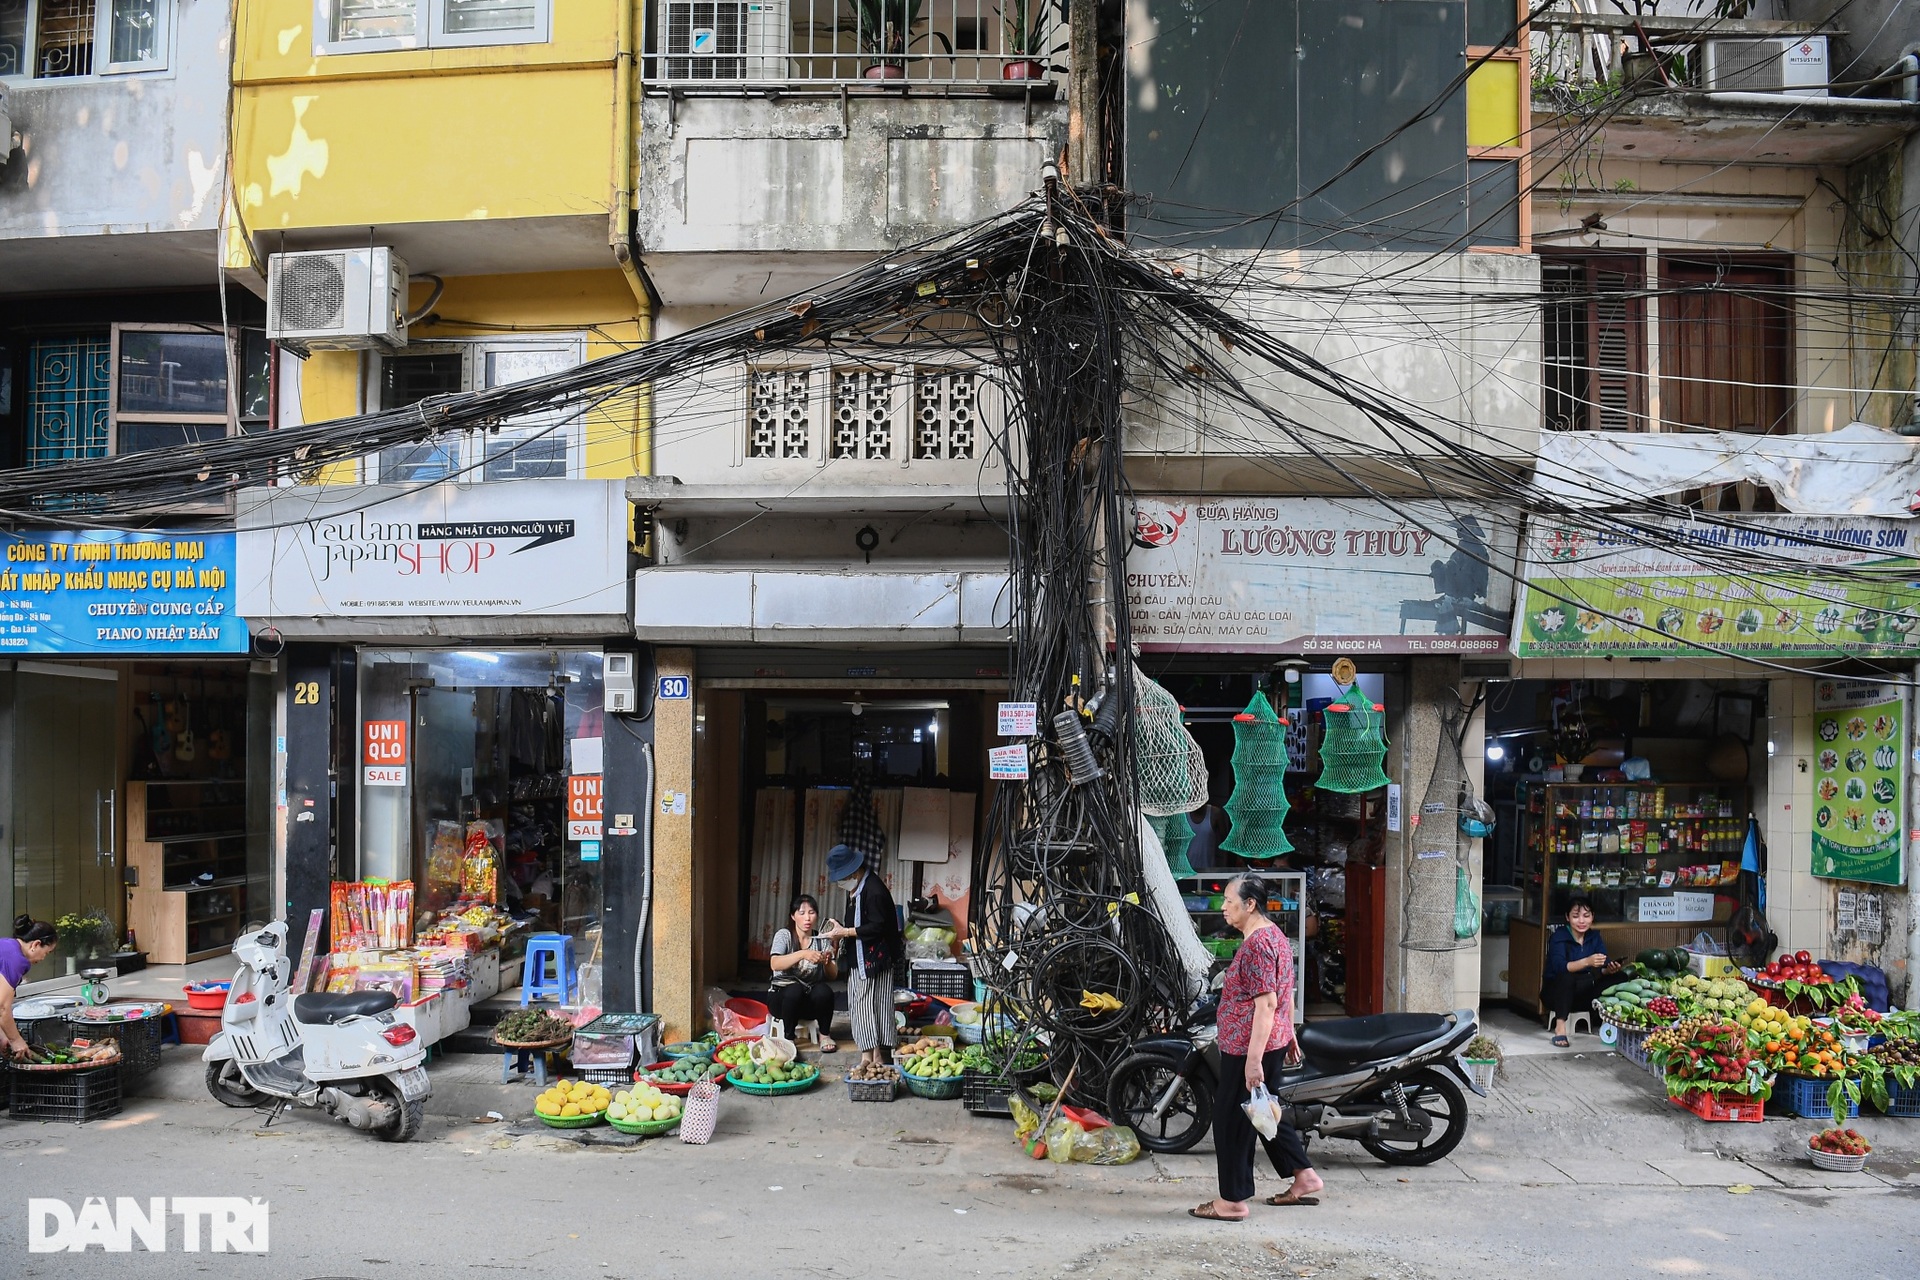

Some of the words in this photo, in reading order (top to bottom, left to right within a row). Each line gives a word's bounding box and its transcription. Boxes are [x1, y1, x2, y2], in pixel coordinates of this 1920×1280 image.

[1196, 502, 1228, 520] CỬA
[1232, 502, 1278, 521] HÀNG
[421, 525, 452, 537] HÀNG
[455, 524, 484, 538] NHẬT
[486, 525, 508, 536] CHO
[511, 520, 545, 535] NGƯỜI
[548, 522, 571, 535] VIỆT
[1875, 529, 1908, 547] SƠN
[1221, 524, 1336, 557] LƯƠNG
[7, 540, 46, 562] CÔNG
[51, 543, 68, 561] TY
[73, 543, 111, 561] TNHH
[115, 540, 171, 560] THƯƠNG
[175, 541, 204, 563] MẠI
[397, 540, 495, 576] SHOP
[0, 567, 18, 591] ẤT
[22, 569, 61, 594] NHẬP
[65, 563, 105, 590] KHẨU
[108, 570, 148, 592] NHẠC
[151, 570, 171, 592] CỤ
[175, 566, 196, 589] HÀ
[200, 566, 226, 591] NỘI
[1127, 573, 1192, 588] CHUYÊN:
[87, 598, 148, 616] CHUYÊN
[150, 602, 192, 616] CUNG
[195, 595, 225, 616] CẤP
[1145, 594, 1167, 605] CÂU
[1200, 594, 1223, 605] CÂU
[1191, 610, 1215, 621] MÁY
[1219, 610, 1241, 621] CÂU
[1244, 609, 1266, 621] CÁC
[1269, 612, 1292, 623] LOẠI
[96, 627, 142, 640] PIANO
[145, 624, 187, 642] NHẬT
[188, 622, 220, 640] BẢN
[1218, 624, 1243, 635] MÁY
[1246, 624, 1268, 635] CÂU
[1303, 636, 1317, 649] SỐ
[1320, 641, 1333, 650] 32
[1336, 641, 1365, 651] NGỌC
[1367, 635, 1382, 649] HÀ
[1408, 641, 1427, 650] TEL:
[1430, 640, 1499, 650] 0984.088869
[294, 682, 320, 704] 28
[663, 680, 684, 697] 30
[368, 724, 399, 740] UNI
[368, 742, 401, 761] QLO
[368, 771, 401, 781] SALE
[573, 780, 603, 796] UNI
